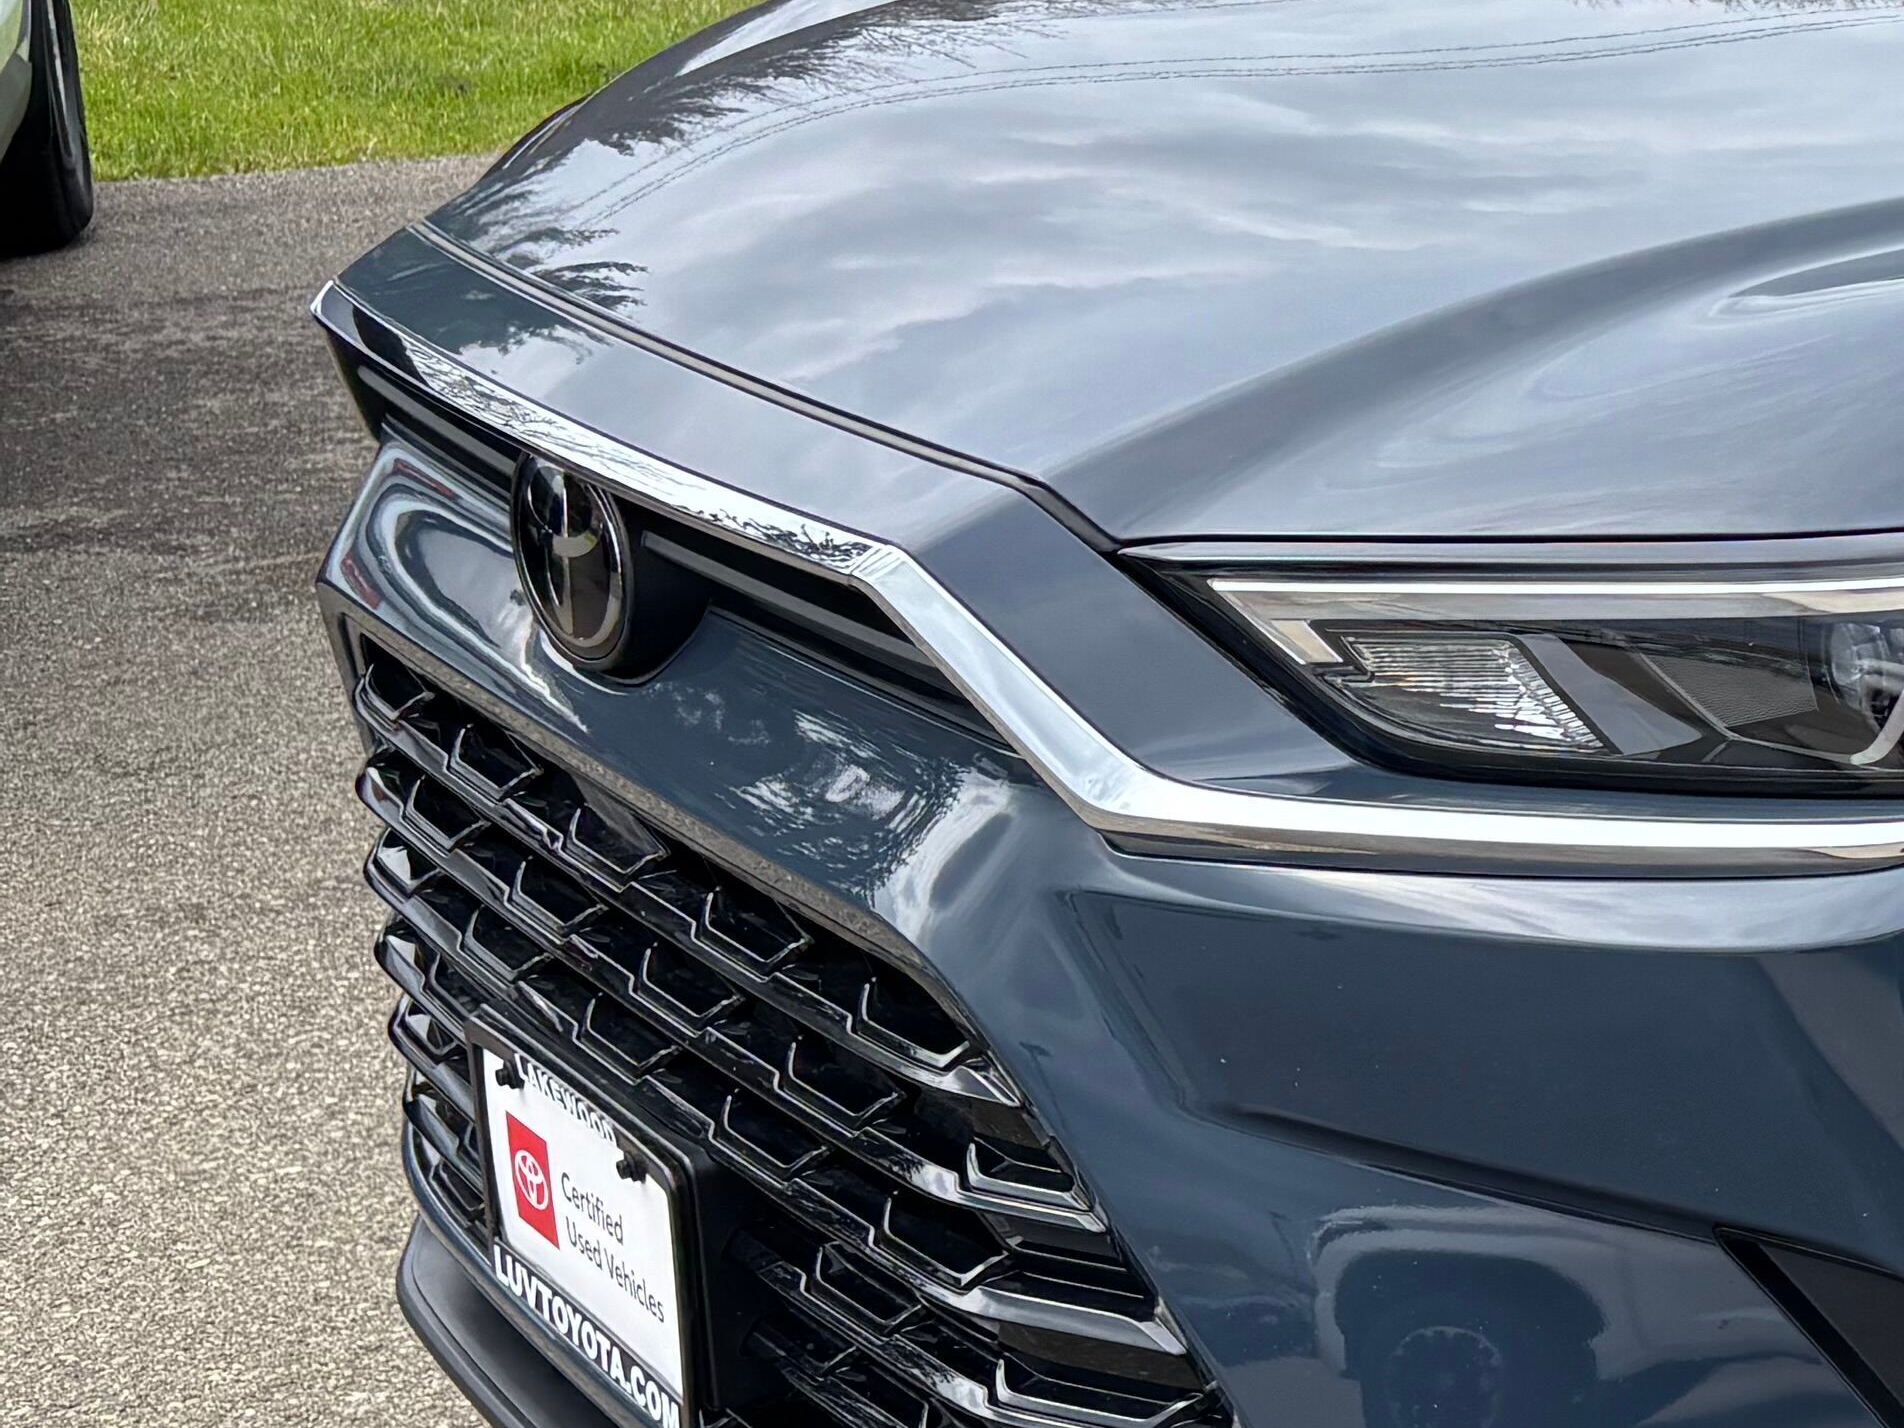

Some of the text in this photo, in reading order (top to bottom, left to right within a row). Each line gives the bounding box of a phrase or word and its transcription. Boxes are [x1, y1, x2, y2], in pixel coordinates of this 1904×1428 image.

[514, 1053, 617, 1147] LAKEWOOD
[561, 1172, 624, 1245] Certified
[566, 1216, 665, 1323] Used Vehicles
